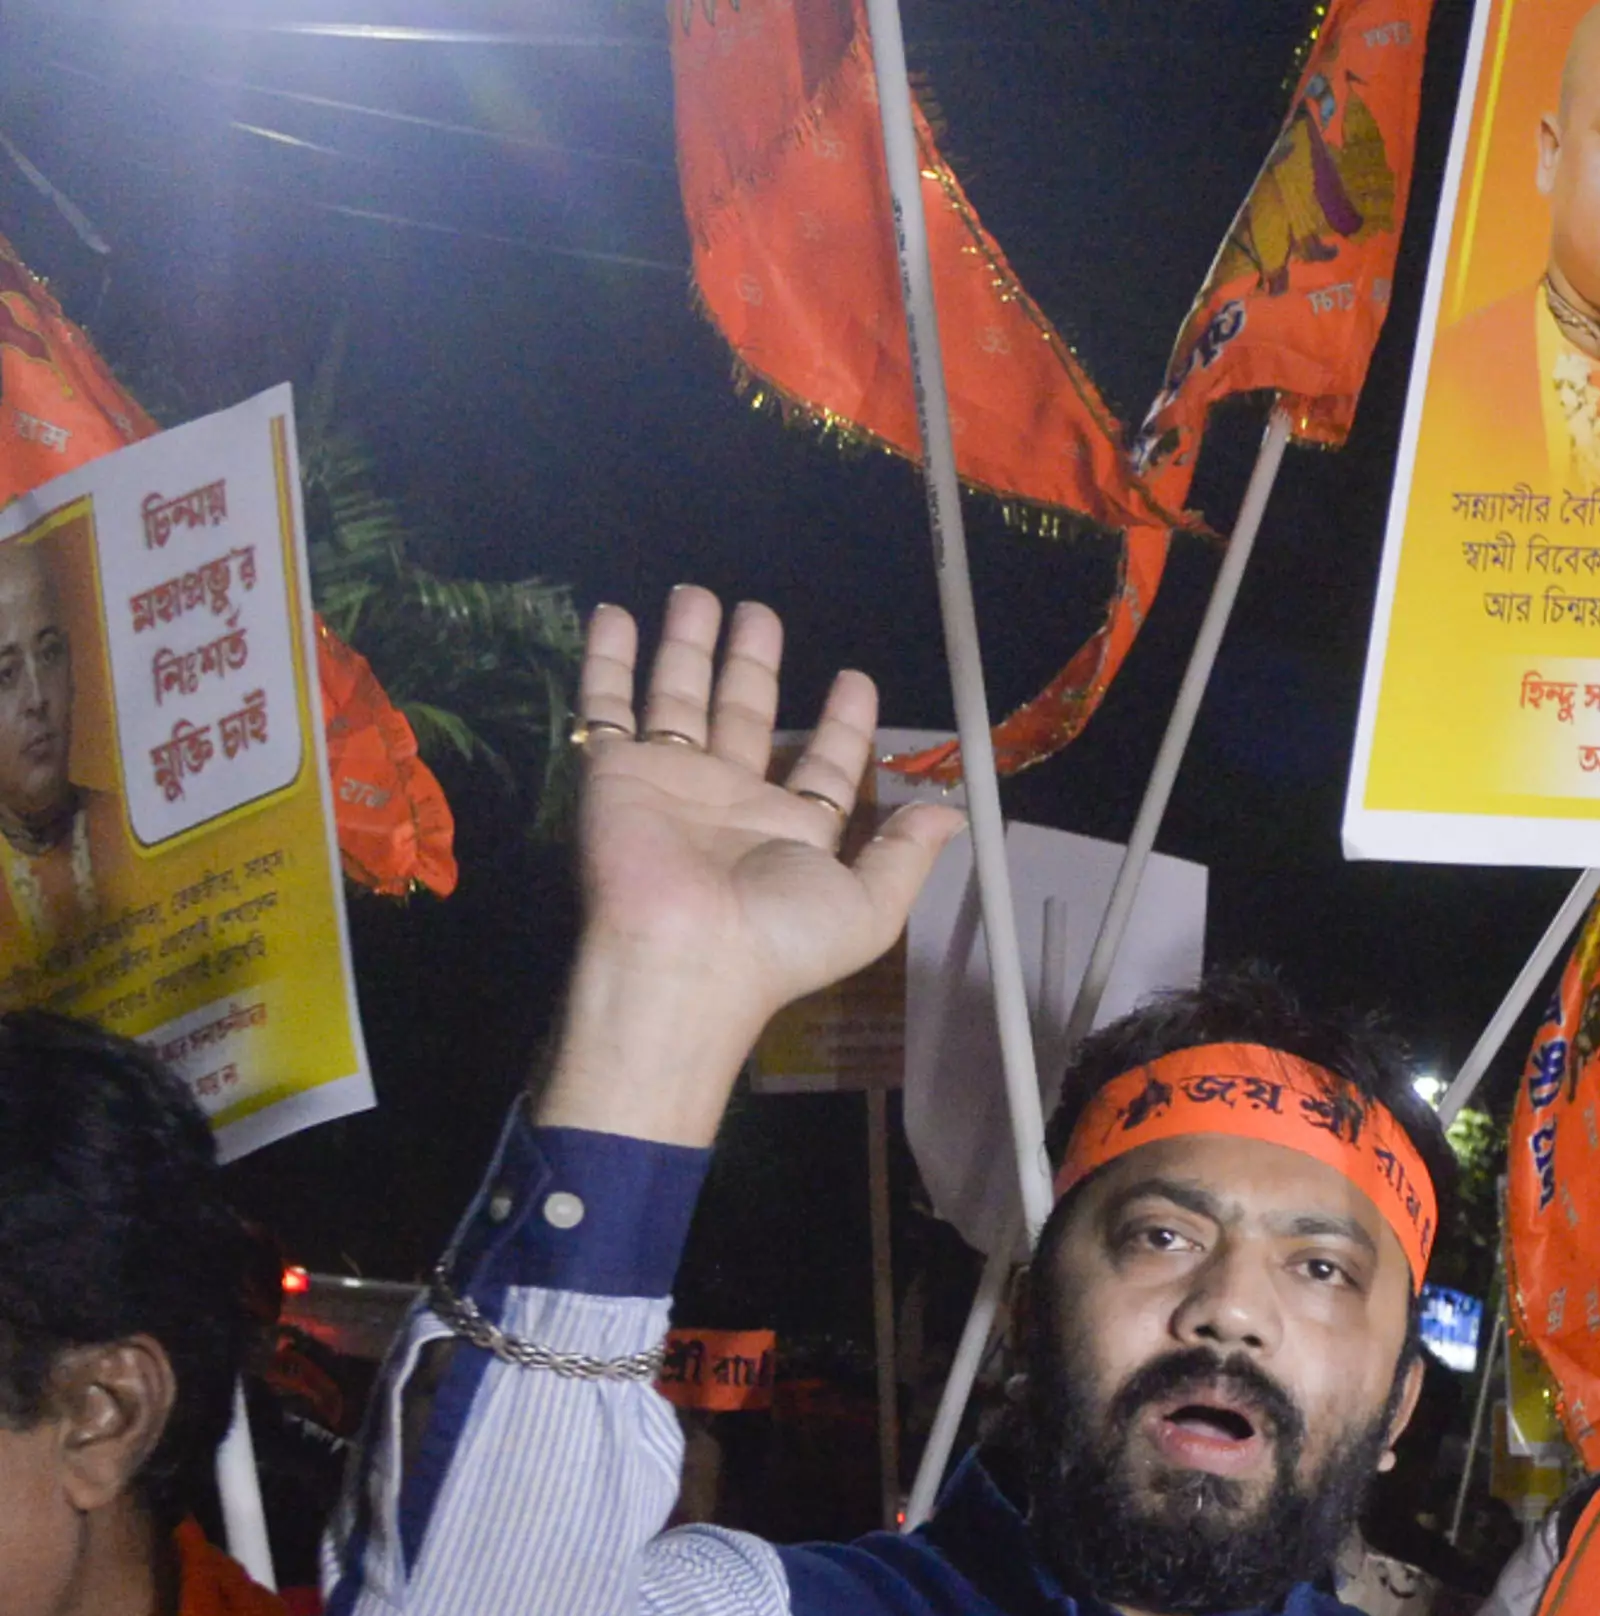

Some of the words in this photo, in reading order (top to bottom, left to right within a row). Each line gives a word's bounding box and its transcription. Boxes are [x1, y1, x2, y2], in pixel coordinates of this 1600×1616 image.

[142, 478, 228, 551] চিন্ময়
[1452, 482, 1551, 525] সন্ন্যাসীর
[1462, 530, 1516, 573] স্বামী
[1484, 591, 1532, 623] আর
[152, 604, 247, 706] নিঃশর্ত
[1519, 670, 1578, 725] হিন্দু
[149, 718, 214, 804] মুক্তি
[219, 688, 270, 760] চাই
[1179, 1075, 1285, 1115] জয়
[1300, 1085, 1368, 1151] শ্রী
[1374, 1148, 1422, 1226] রাম
